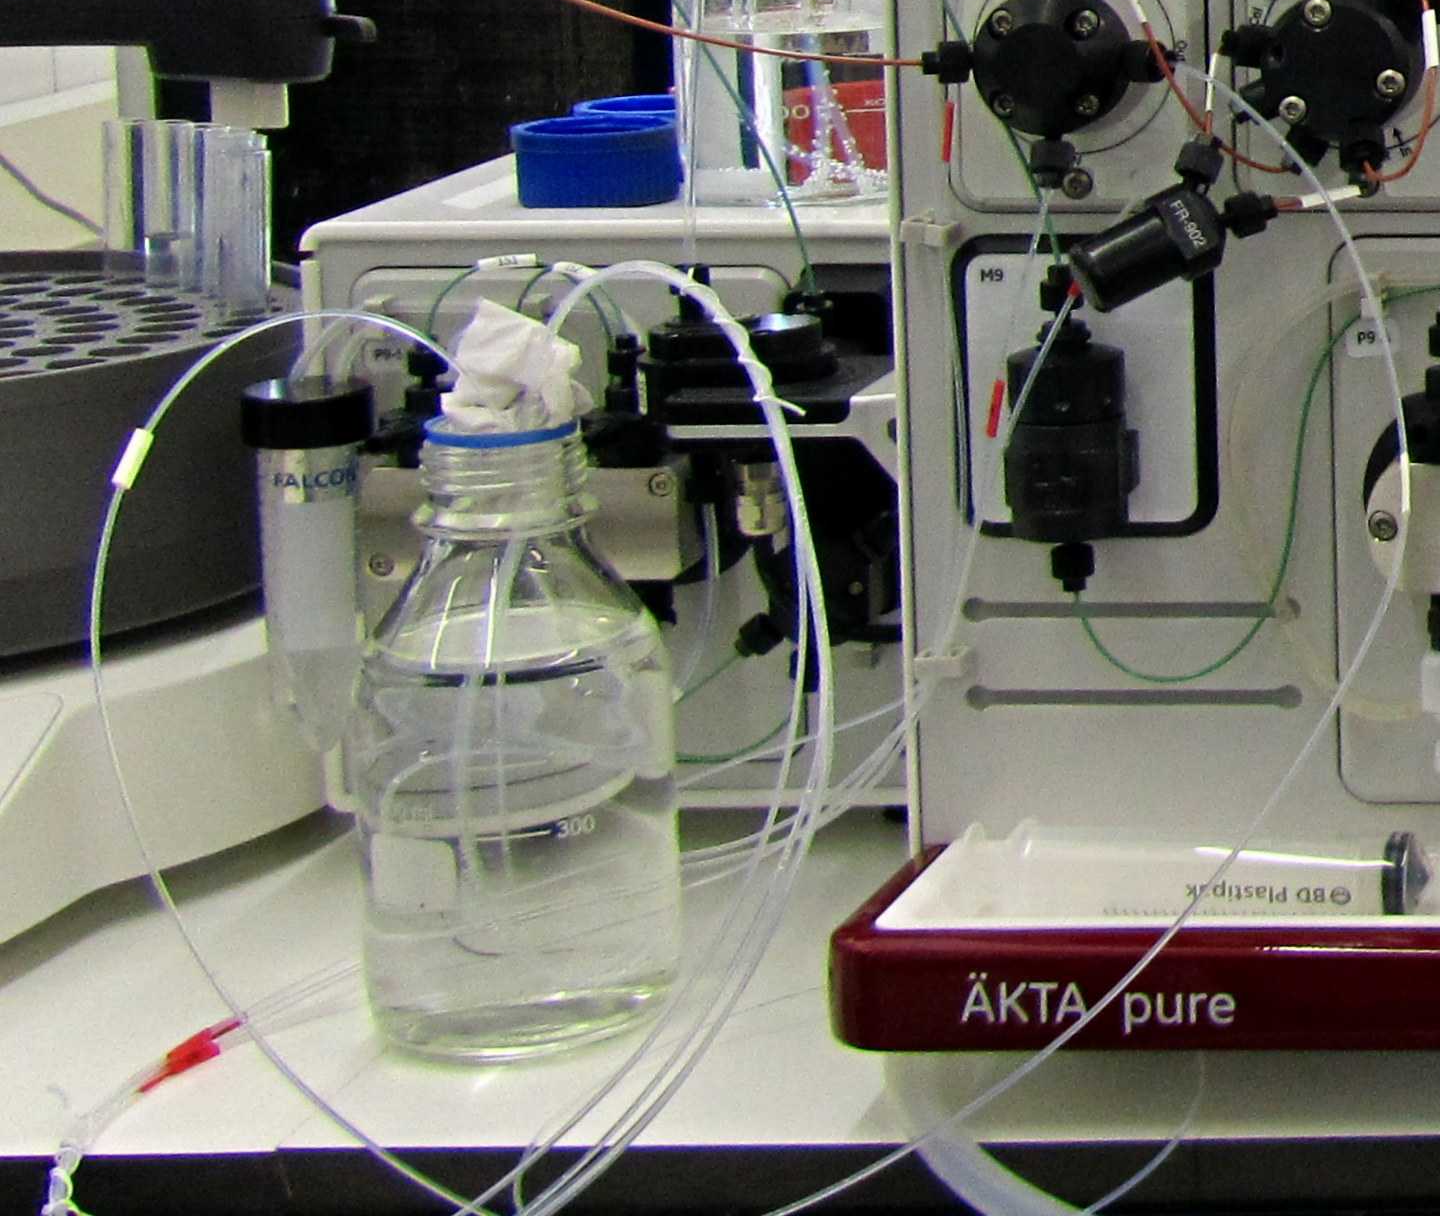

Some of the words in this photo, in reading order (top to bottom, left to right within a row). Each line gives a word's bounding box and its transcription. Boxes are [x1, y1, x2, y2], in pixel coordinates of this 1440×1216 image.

[1169, 199, 1208, 248] FR-902
[980, 269, 1004, 283] M9
[1357, 331, 1376, 345] P9
[558, 814, 596, 839] 300
[1296, 886, 1326, 904] BD
[961, 971, 1090, 1024] ÄKTA
[1121, 990, 1237, 1034] pure
